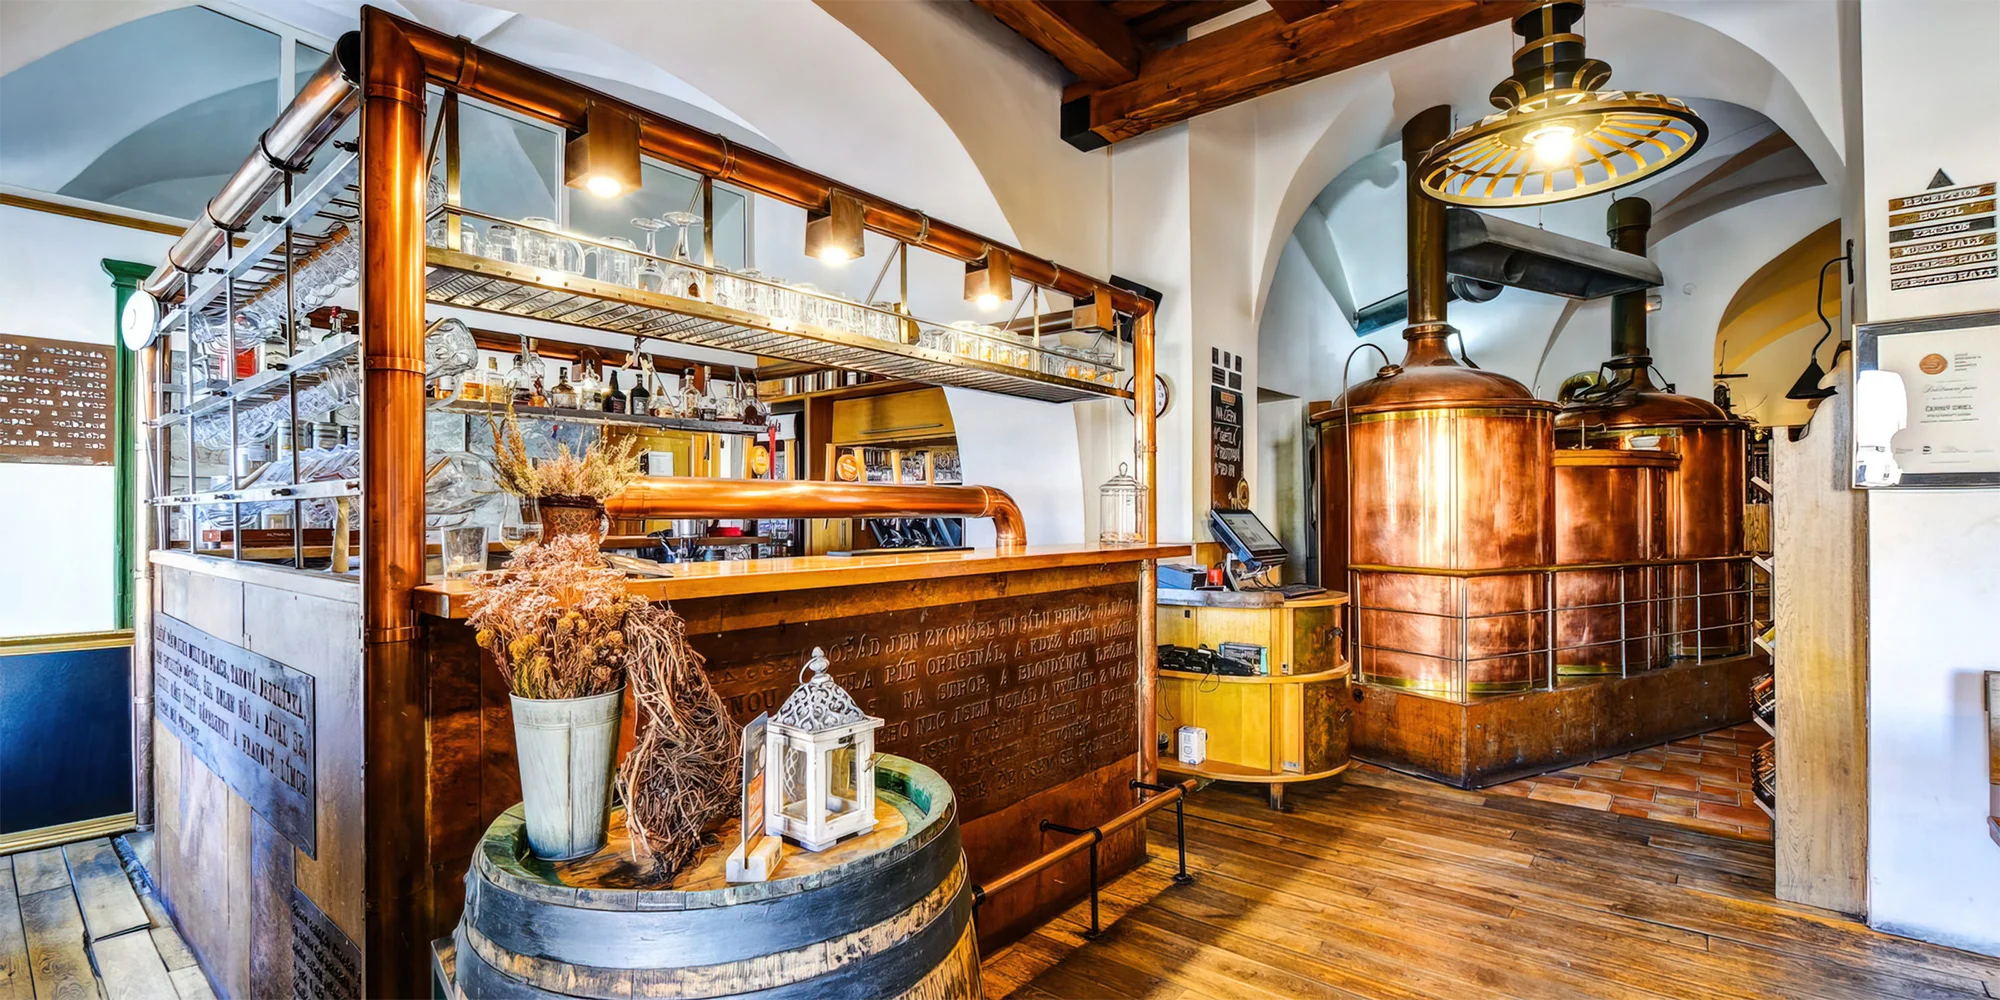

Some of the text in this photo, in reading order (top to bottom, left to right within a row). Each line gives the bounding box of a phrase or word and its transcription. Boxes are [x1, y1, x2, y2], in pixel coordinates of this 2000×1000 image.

[1903, 188, 1980, 207] RECEPTION
[1919, 207, 1964, 220] HOTEL
[1912, 223, 1970, 238] PENSION
[885, 632, 919, 654] JEN
[998, 619, 1015, 636] TU
[884, 654, 917, 684] PÍT
[1014, 641, 1022, 659] A
[902, 686, 924, 710] NA
[1000, 667, 1008, 686] A
